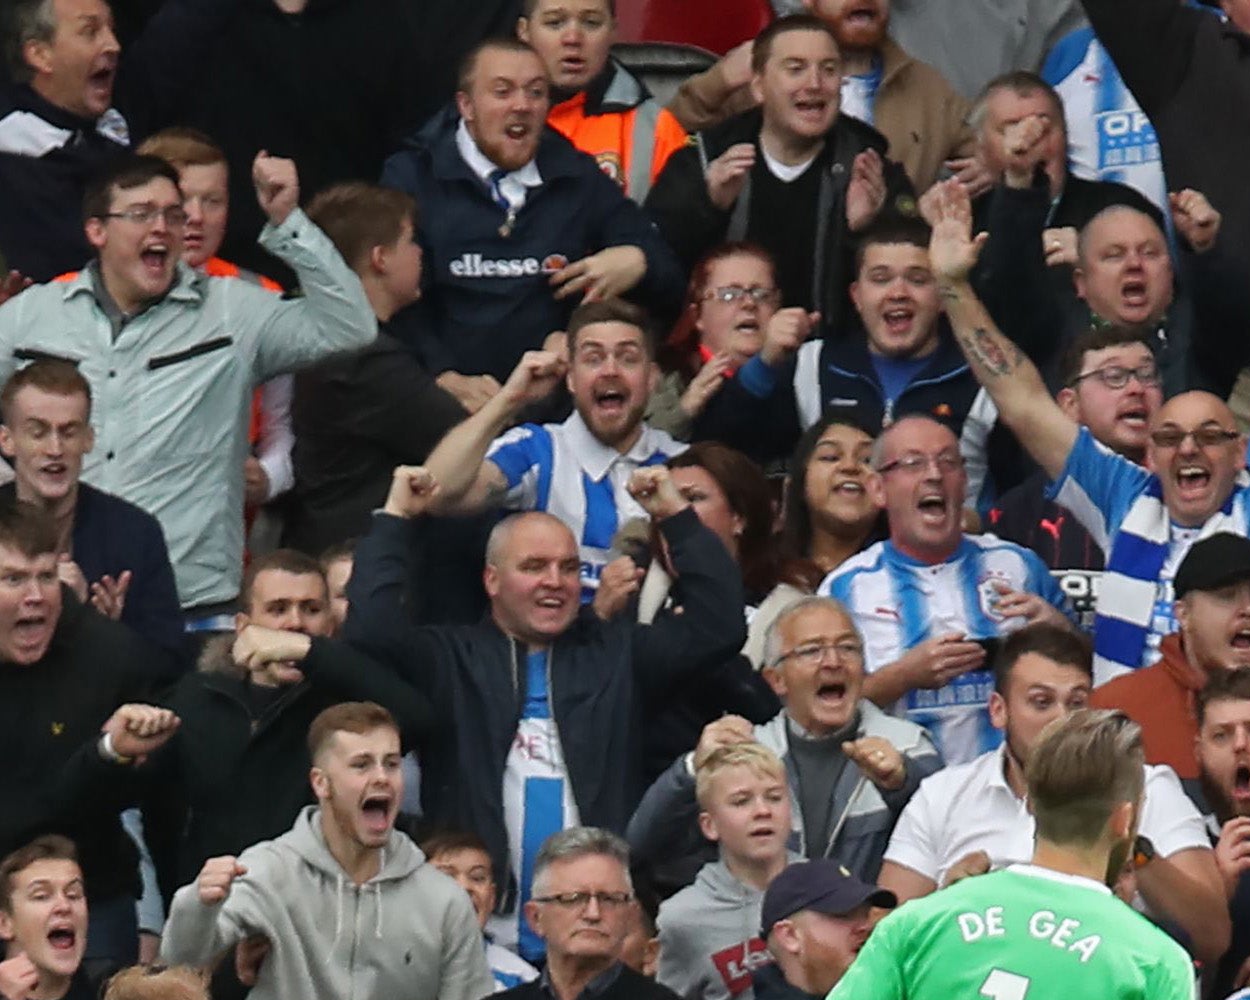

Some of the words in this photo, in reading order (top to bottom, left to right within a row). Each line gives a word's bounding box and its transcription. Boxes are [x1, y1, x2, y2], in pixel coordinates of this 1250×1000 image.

[449, 253, 539, 276] ellesse
[957, 906, 1005, 942] DE
[1028, 910, 1101, 963] GEA
